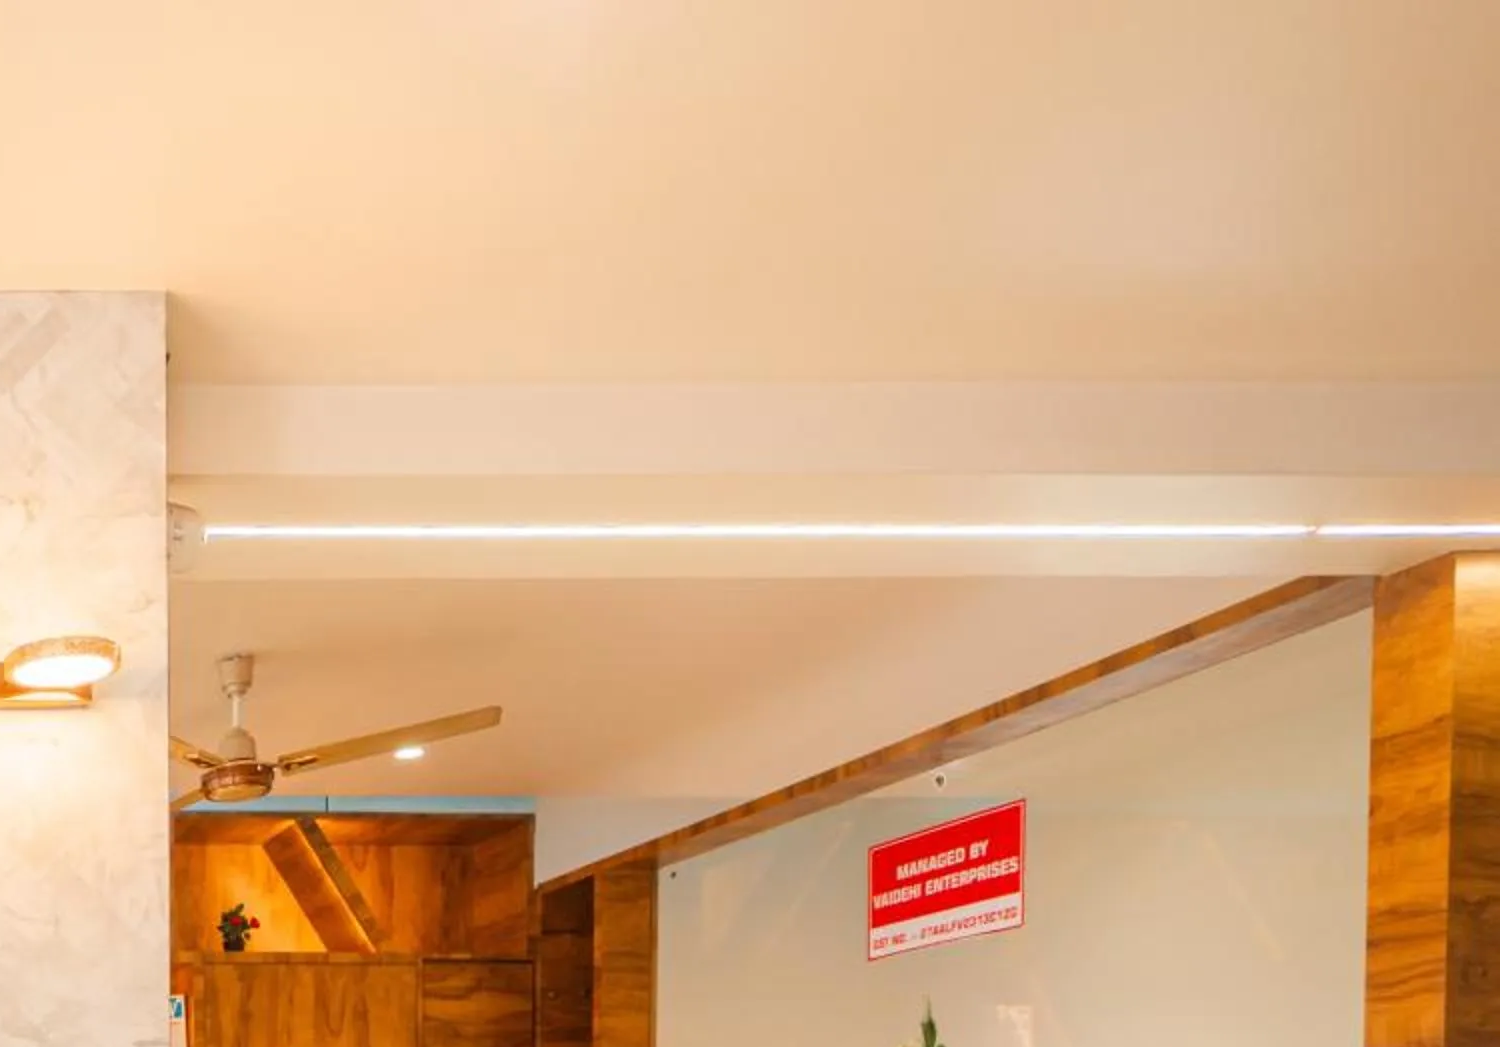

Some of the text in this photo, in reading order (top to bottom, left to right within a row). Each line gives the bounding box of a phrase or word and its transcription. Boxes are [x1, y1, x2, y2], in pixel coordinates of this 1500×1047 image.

[873, 856, 1019, 909] VAIDEHI ENTERPRISES
[896, 839, 989, 880] MANAGED BY
